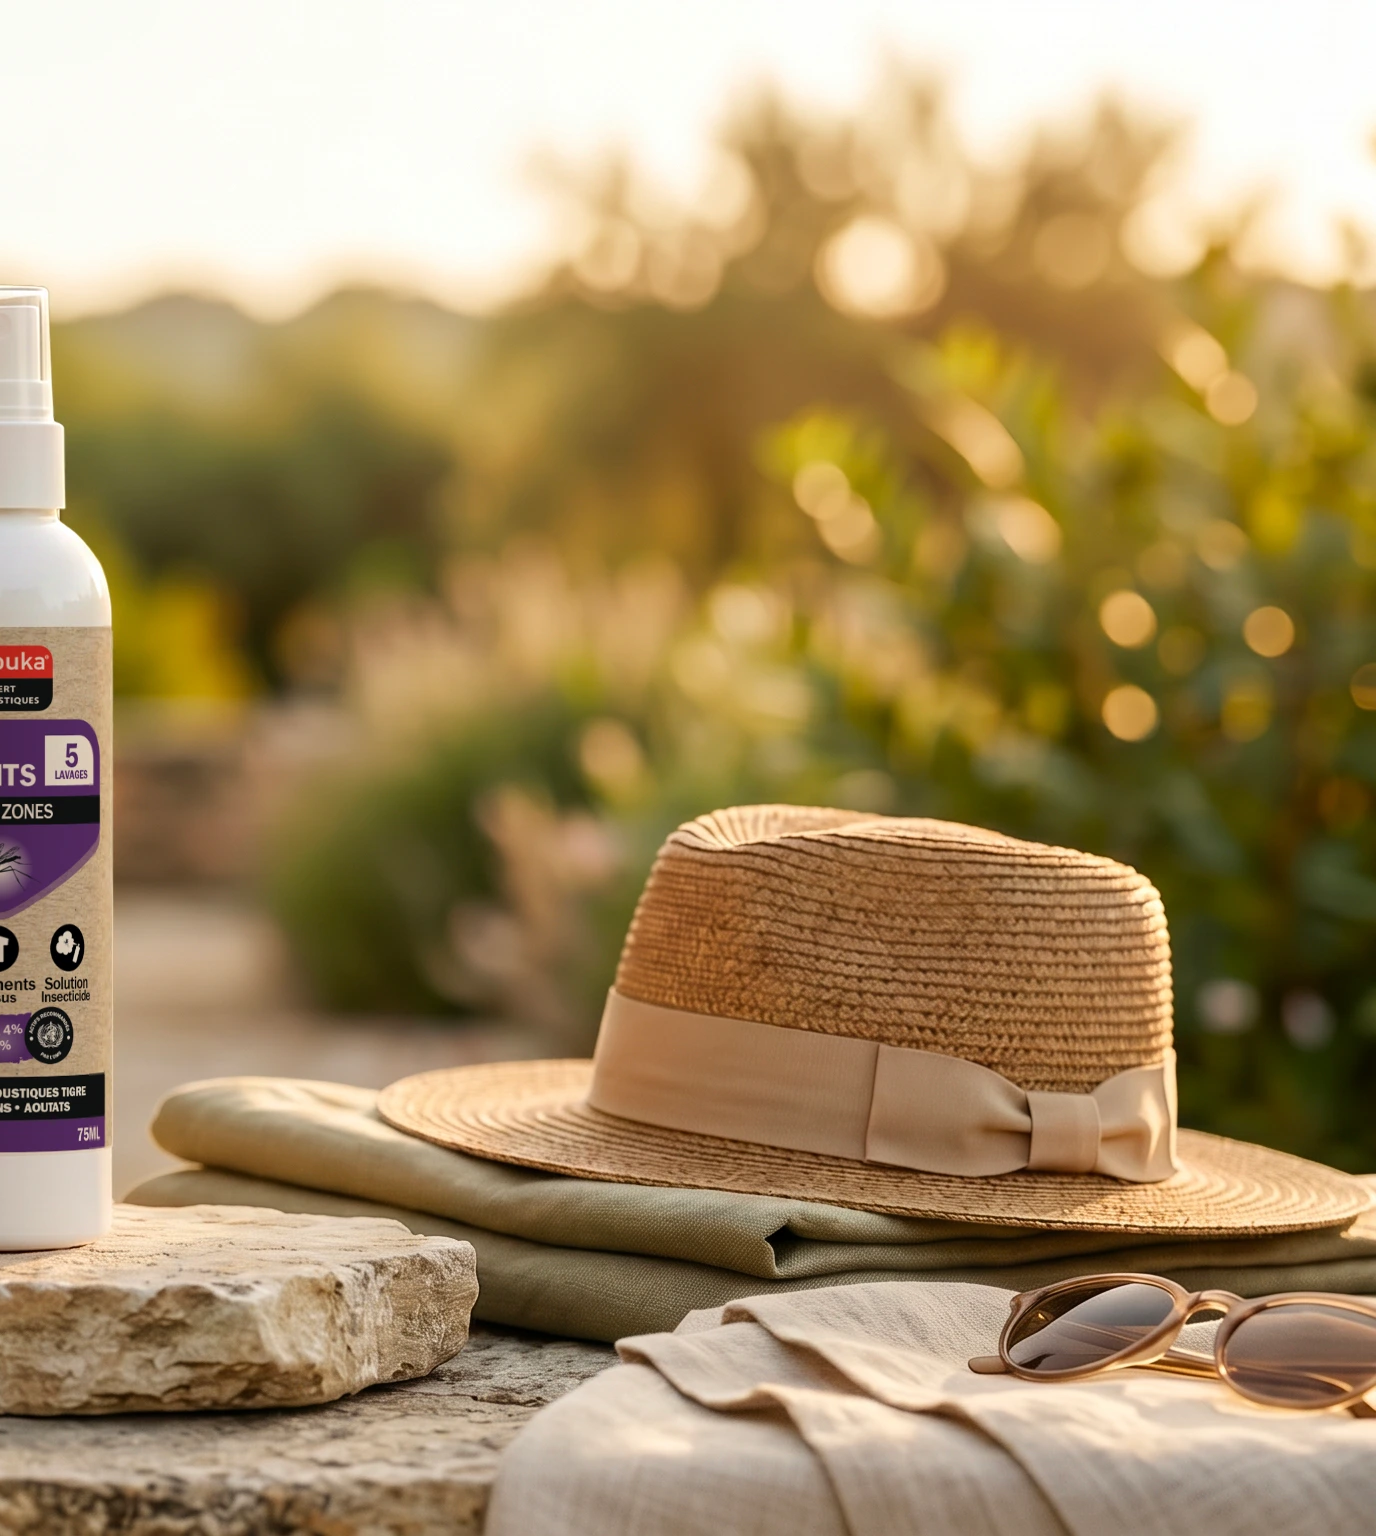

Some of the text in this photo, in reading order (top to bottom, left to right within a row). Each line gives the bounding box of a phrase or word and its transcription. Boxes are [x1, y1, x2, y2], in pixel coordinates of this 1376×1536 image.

[65, 743, 78, 767] 5
[54, 770, 88, 780] LAVAGES
[1, 803, 54, 820] ZONES
[44, 976, 88, 990] Solution
[41, 990, 90, 1003] Insecticide
[3, 1023, 23, 1035] 4%
[61, 1085, 87, 1097] TIGRE
[24, 1101, 71, 1113] AOUTATS
[77, 1126, 100, 1142] 75ML
